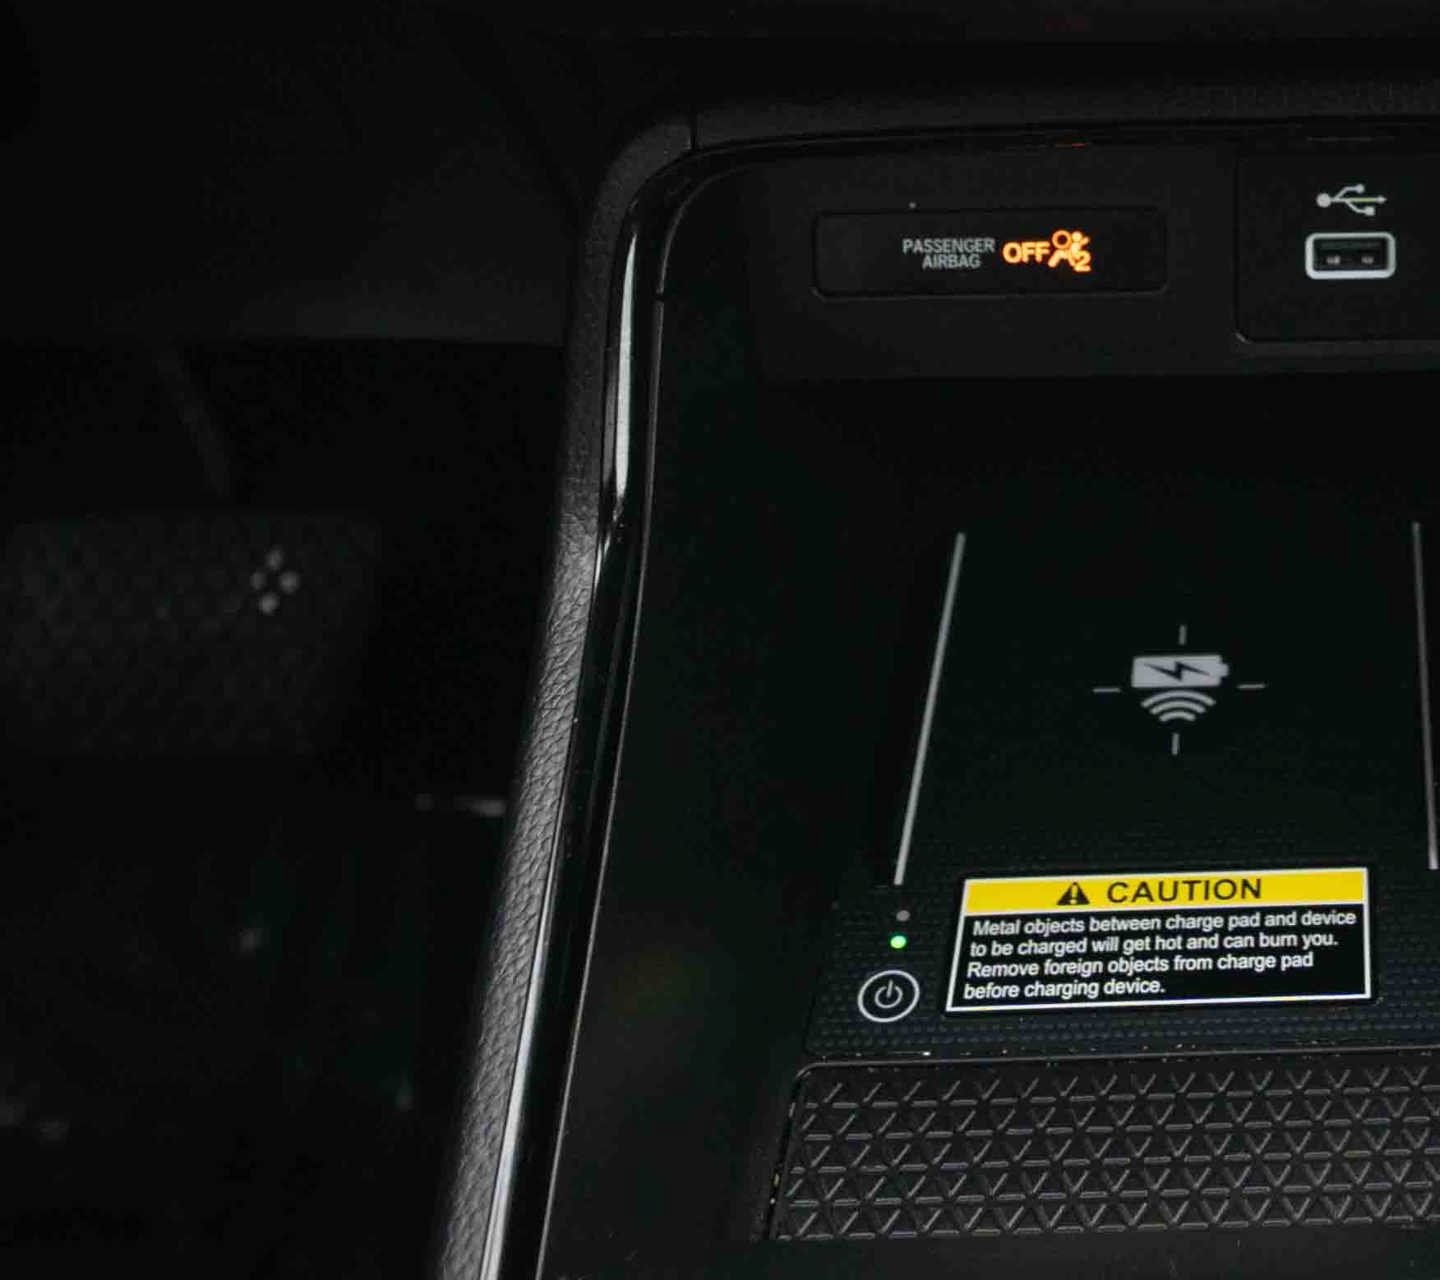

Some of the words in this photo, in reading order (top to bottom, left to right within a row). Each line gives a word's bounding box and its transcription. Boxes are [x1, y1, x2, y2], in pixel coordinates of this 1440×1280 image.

[902, 237, 996, 255] PASSENGER
[1002, 241, 1050, 263] OFF
[922, 254, 981, 270] AIRBAG
[1107, 879, 1262, 904] CAUTION
[973, 919, 1020, 936] Metal
[1024, 917, 1085, 938] objects
[1089, 915, 1160, 932] between
[1166, 913, 1223, 934] charge
[1229, 912, 1259, 932] pad
[1265, 911, 1296, 927] and
[1300, 910, 1357, 926] device
[970, 940, 986, 957] to
[990, 939, 1013, 956] be
[1018, 937, 1087, 959] charged
[1091, 936, 1118, 953] will
[1123, 935, 1150, 956] get
[1155, 935, 1181, 951] hot
[1186, 934, 1218, 950] and
[1223, 936, 1254, 949] can
[1259, 932, 1298, 948] burn
[1302, 934, 1338, 951] you.
[967, 959, 1039, 977] Remove
[1044, 958, 1104, 979] foreign
[1109, 956, 1168, 977] objects
[1174, 954, 1212, 971] from
[1217, 953, 1275, 974] charge
[1281, 952, 1313, 972] pad
[964, 981, 1020, 999] before
[1024, 979, 1099, 1001] charging
[1104, 977, 1165, 995] device.
